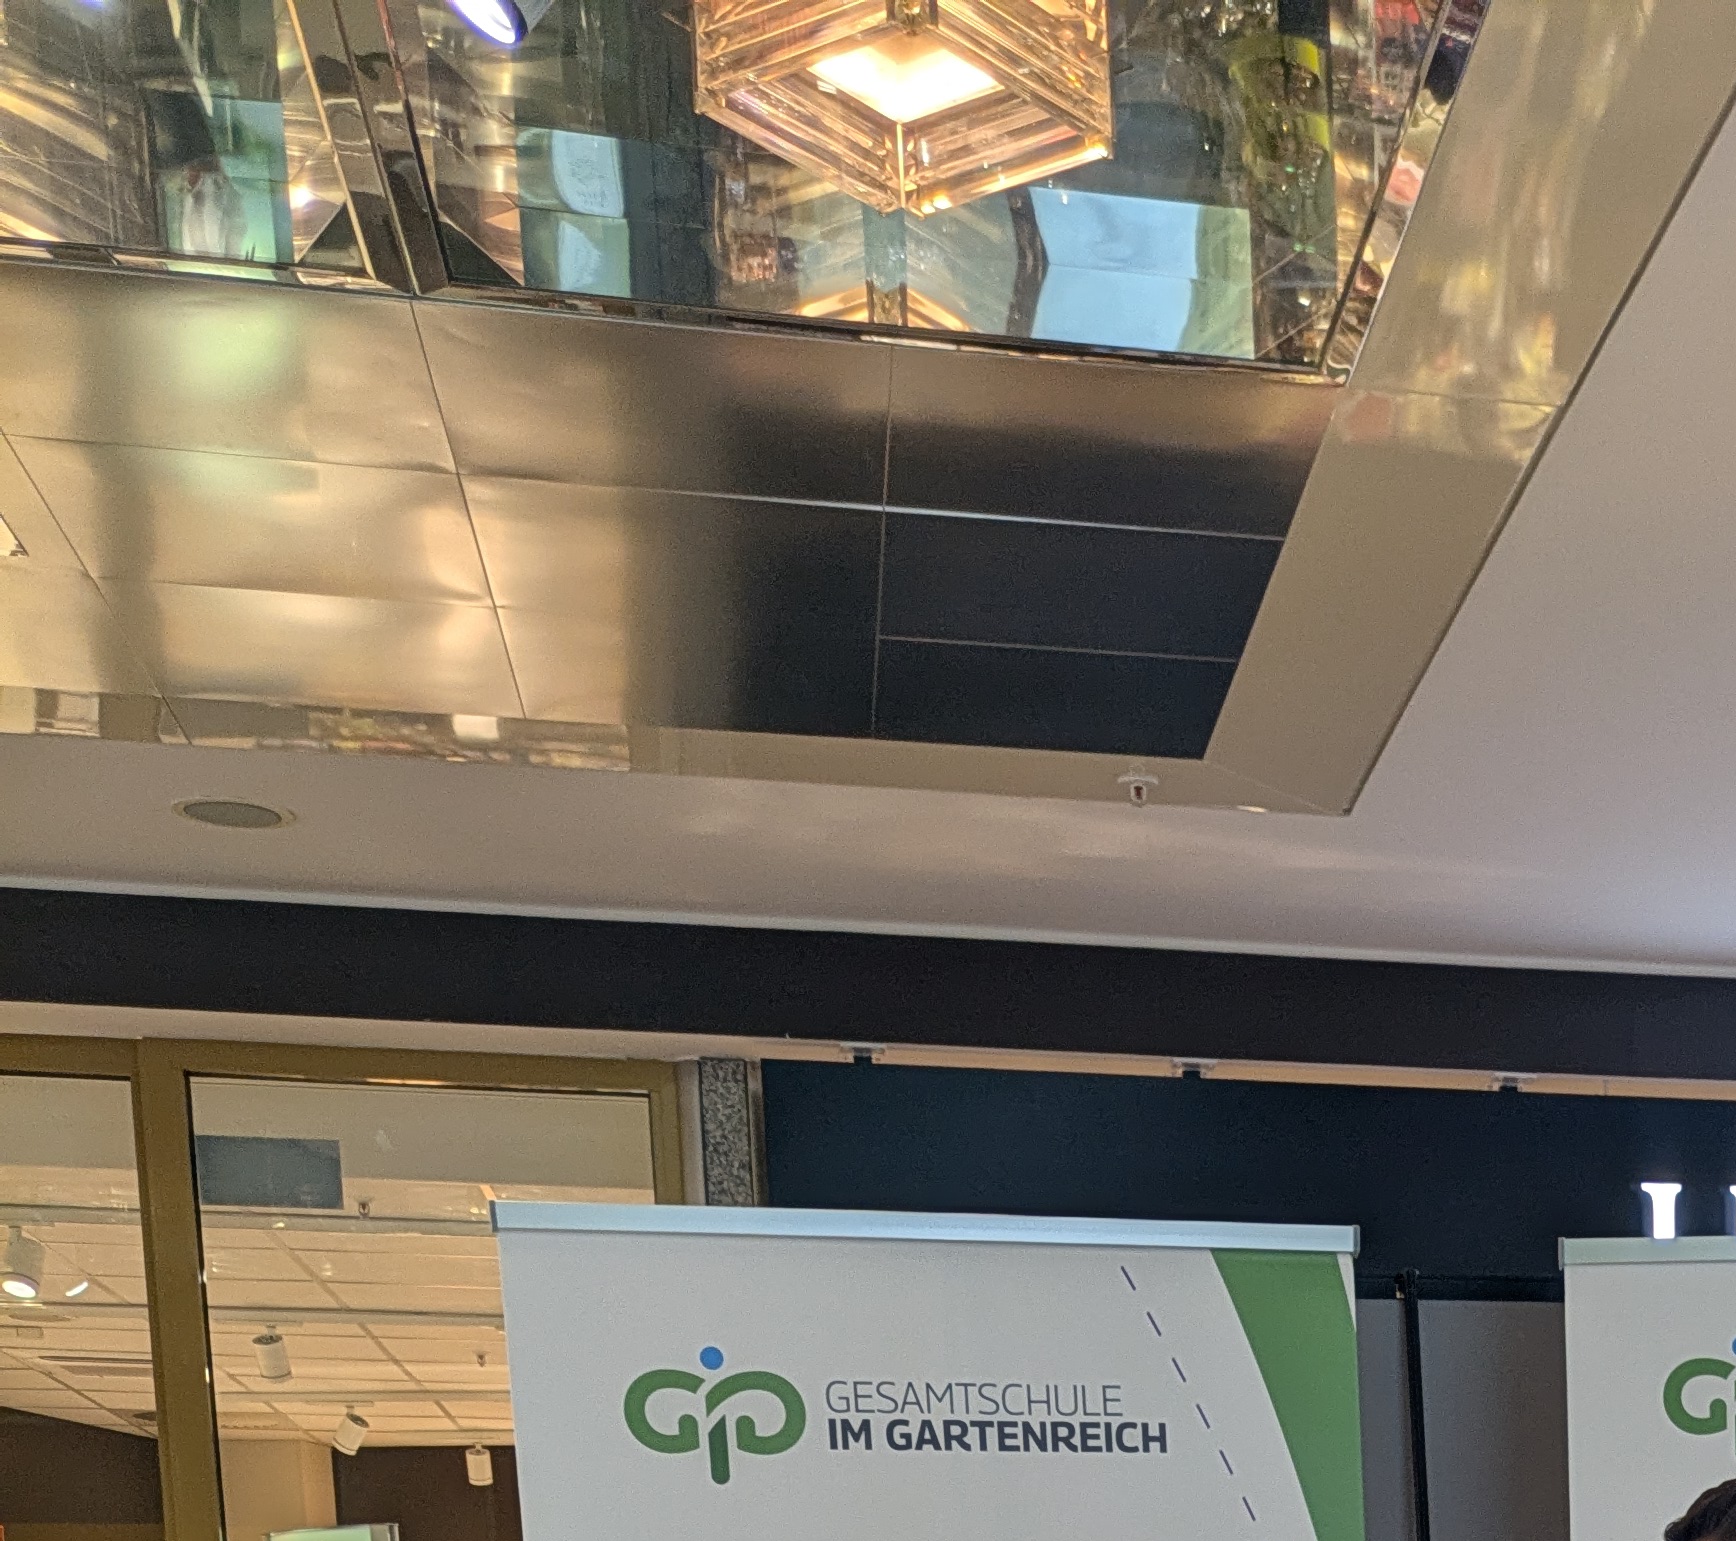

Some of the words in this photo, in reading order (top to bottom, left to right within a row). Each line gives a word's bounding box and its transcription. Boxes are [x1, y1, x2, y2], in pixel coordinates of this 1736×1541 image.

[825, 1380, 1123, 1418] GESAMTSCHULE
[828, 1418, 872, 1451] IM
[886, 1420, 1168, 1454] GARTENREICH
